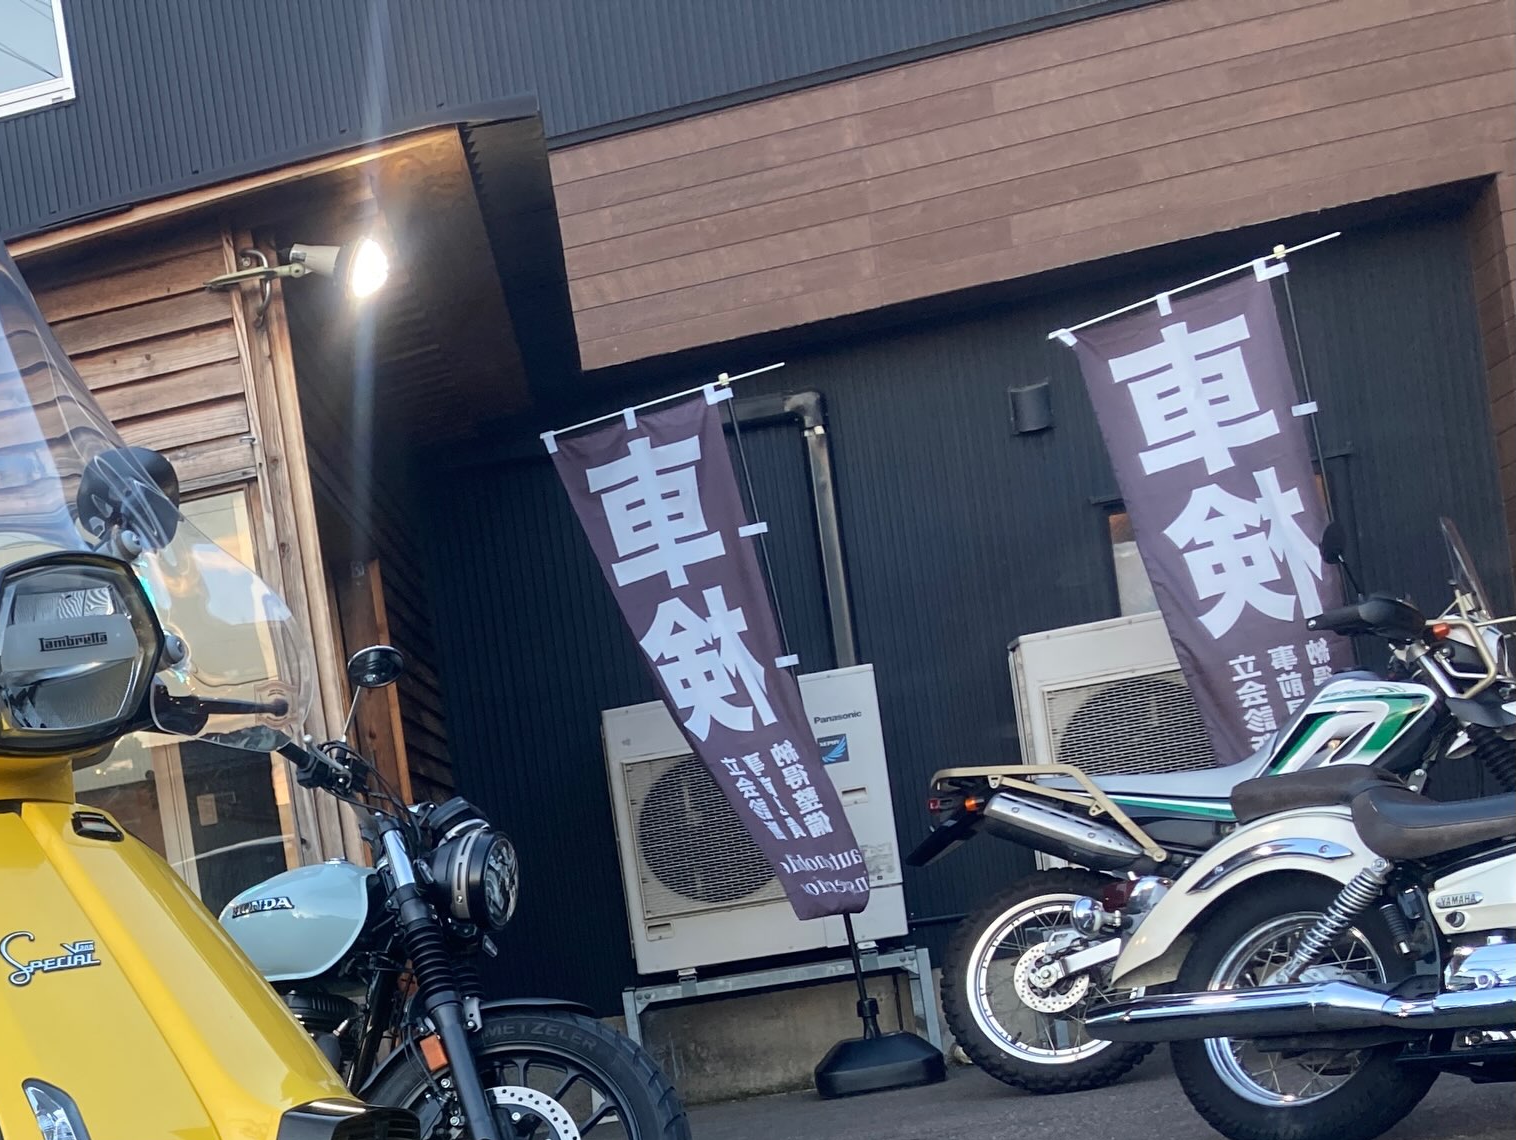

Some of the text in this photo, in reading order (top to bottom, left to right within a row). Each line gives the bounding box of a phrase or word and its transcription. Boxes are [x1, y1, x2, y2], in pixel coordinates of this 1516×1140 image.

[813, 710, 862, 724] Panasonic
[232, 896, 295, 919] HONDA
[1440, 893, 1476, 907] YAMAHA
[483, 1021, 598, 1050] METZELER
